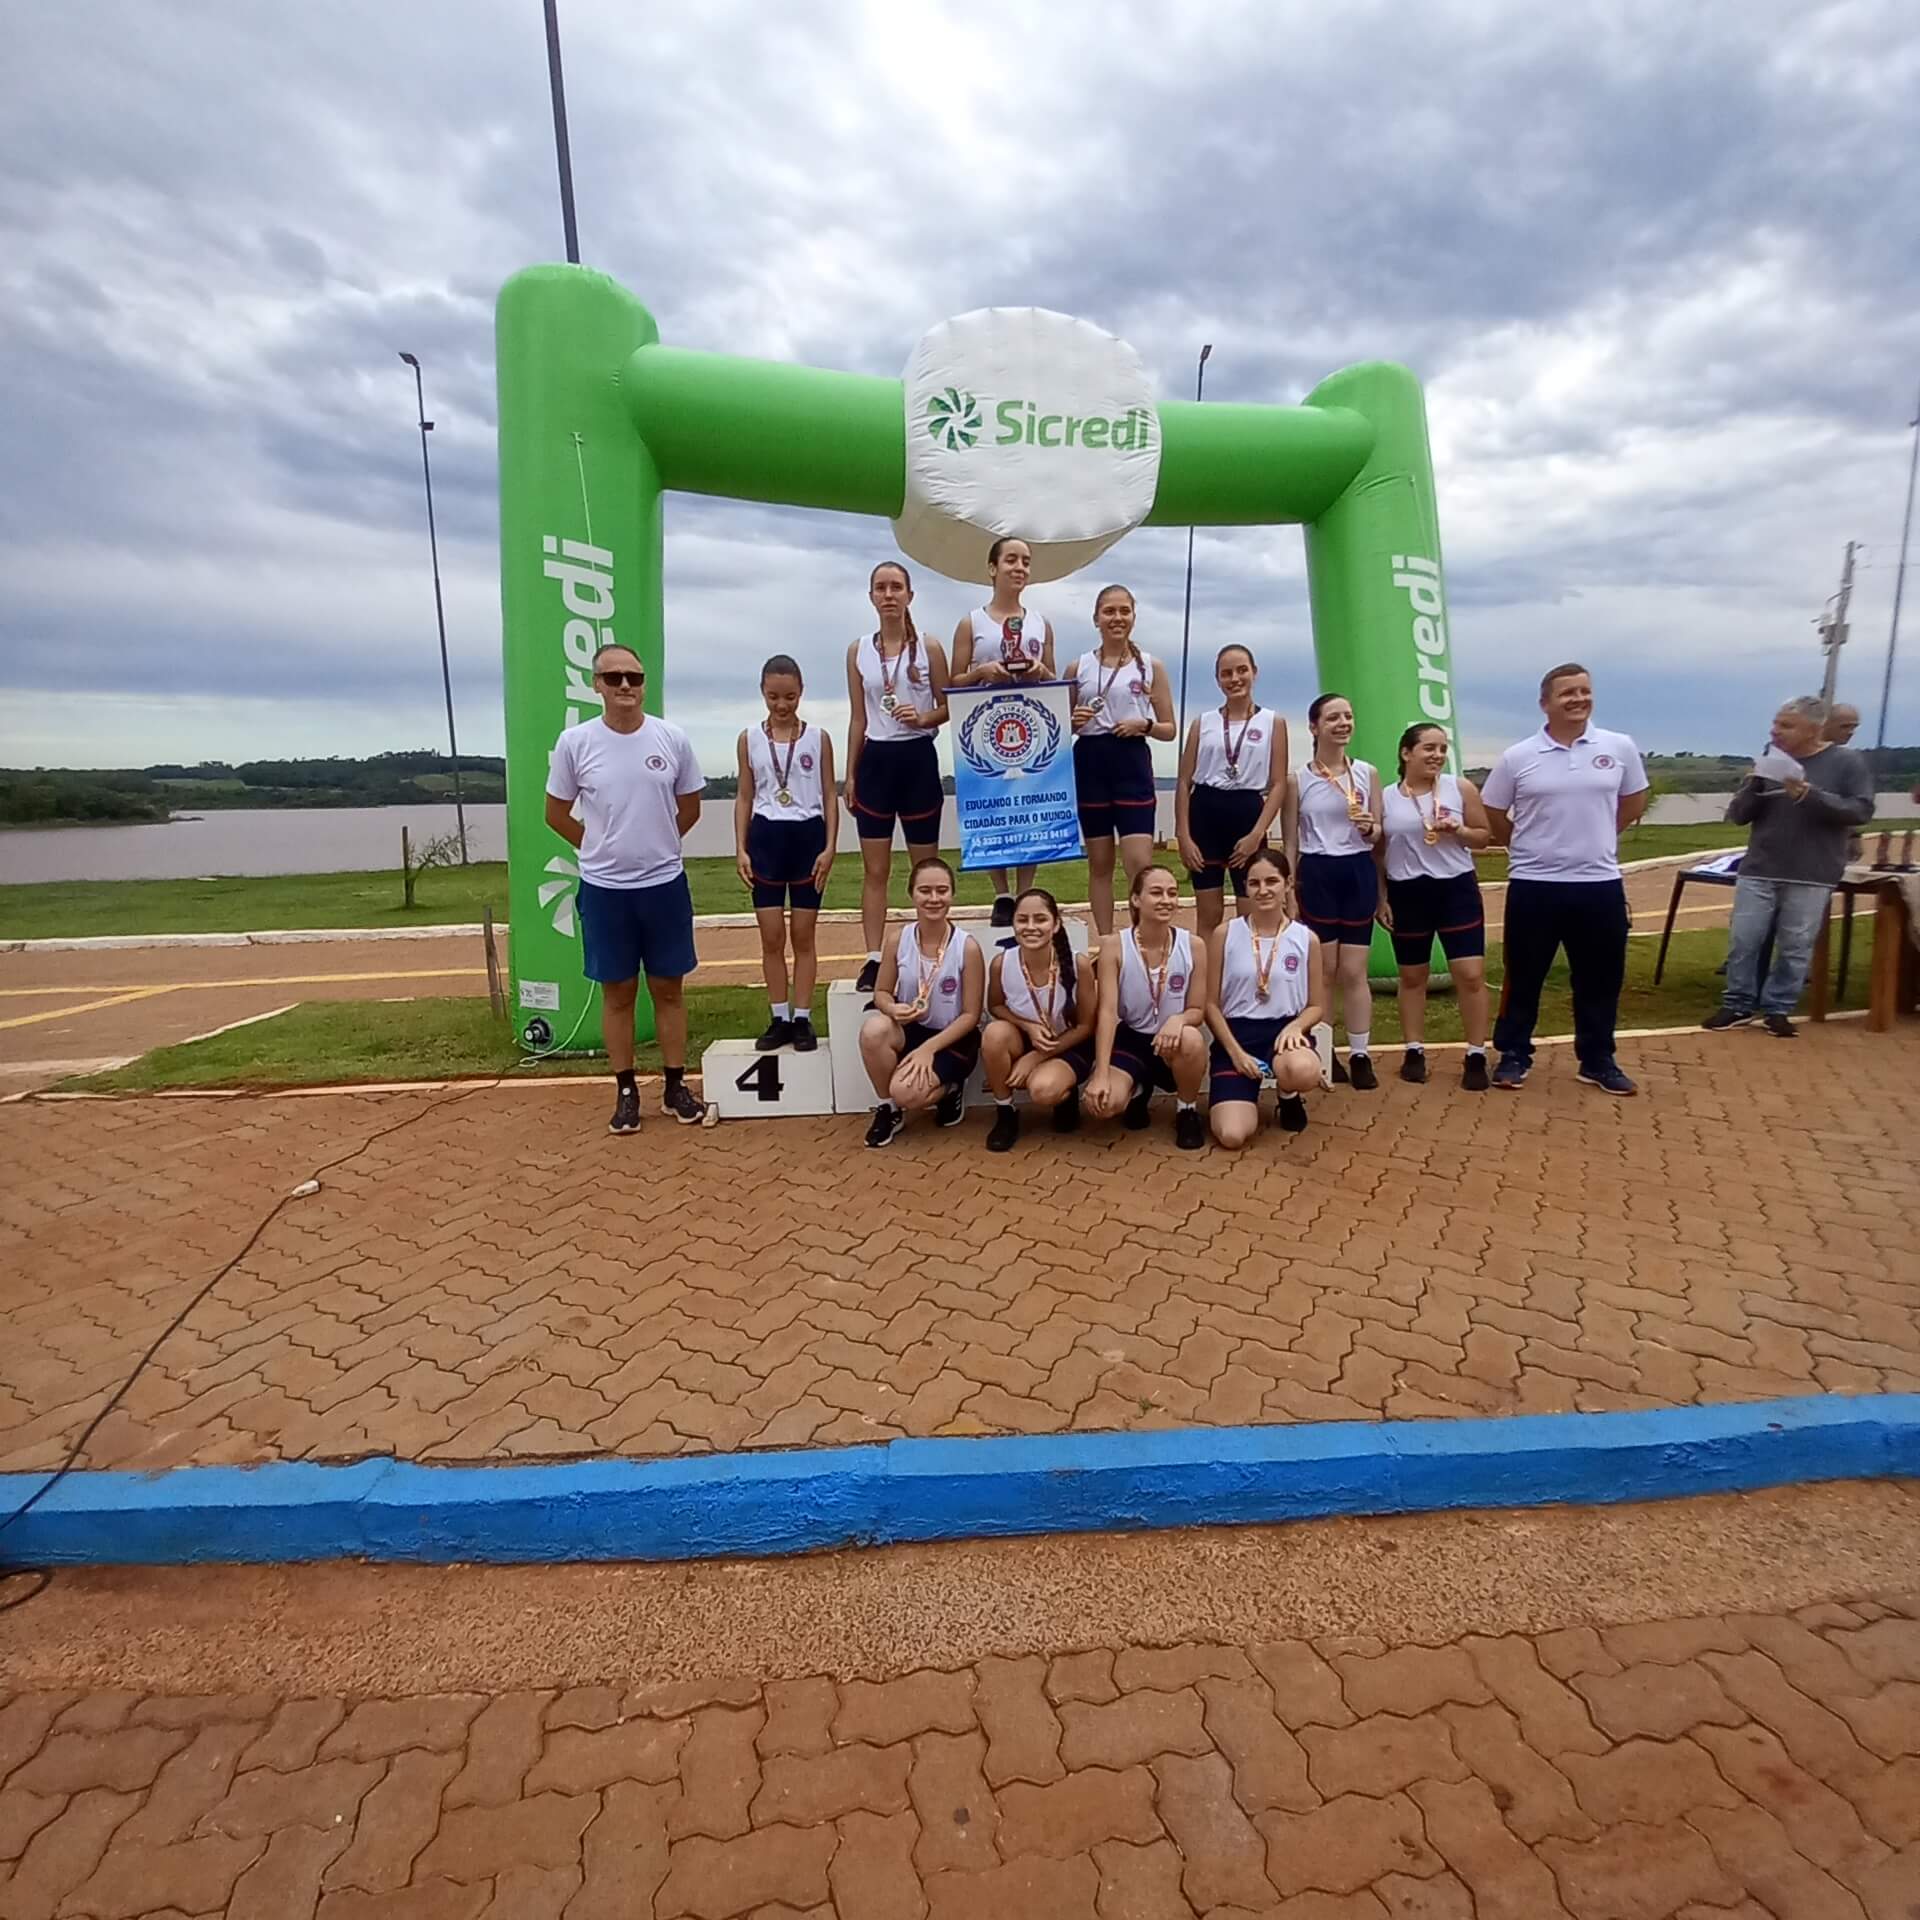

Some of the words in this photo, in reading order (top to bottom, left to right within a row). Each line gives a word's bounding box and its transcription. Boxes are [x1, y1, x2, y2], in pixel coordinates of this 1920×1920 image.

[995, 400, 1150, 451] Sicredi
[543, 535, 618, 800] redi
[1391, 554, 1457, 774] credi
[964, 815, 1007, 830] CIDADÃOS
[1008, 814, 1031, 826] PARA
[1032, 813, 1039, 822] O
[1040, 809, 1072, 821] MUNDO
[965, 796, 1012, 811] EDUCANDO
[1014, 795, 1021, 806] E
[1021, 791, 1068, 805] FORMANDO
[735, 1055, 785, 1102] 4
